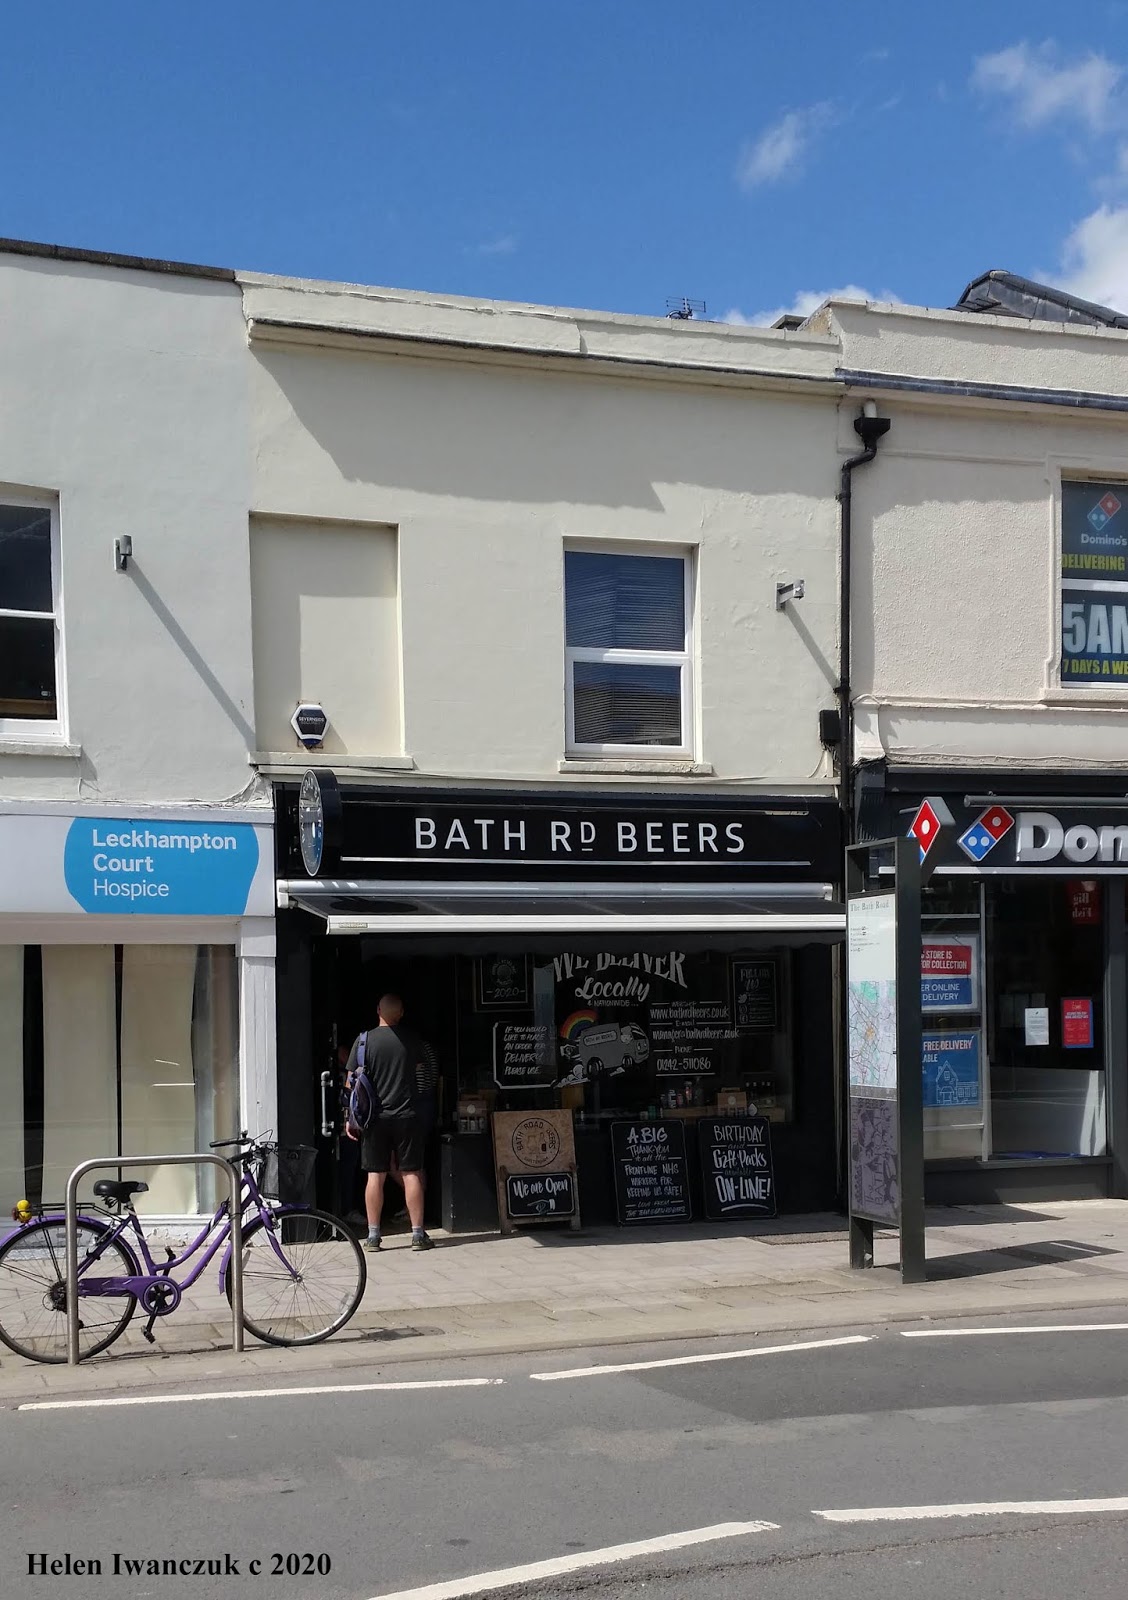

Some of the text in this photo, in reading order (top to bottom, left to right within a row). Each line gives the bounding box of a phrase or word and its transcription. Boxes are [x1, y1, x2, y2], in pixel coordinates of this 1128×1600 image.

[1081, 533, 1127, 547] Domino's
[1062, 553, 1125, 571] DELIVERING
[1064, 659, 1070, 673] 7
[1071, 659, 1100, 674] DAYS
[1102, 660, 1110, 674] A
[93, 829, 237, 853] Leckhampton
[414, 818, 526, 850] BATH
[617, 822, 746, 853] BEERS
[94, 854, 154, 873] Court
[94, 878, 169, 901] Hospice
[850, 900, 890, 911] The Bath Road
[926, 950, 945, 959] STORE
[946, 950, 953, 959] IS
[931, 960, 968, 969] COLLECTION
[495, 987, 520, 999] 2020
[575, 976, 651, 1002] Locally
[931, 983, 960, 991] ONLINE
[922, 993, 959, 1001] DELIVERY
[923, 1039, 973, 1051] FREE DELIVERY
[657, 1057, 712, 1071] 01242-511086
[516, 1131, 525, 1151] BATH
[523, 1121, 544, 1130] ROAD
[627, 1127, 668, 1144] A BIG
[713, 1125, 764, 1142] BIRTHDAY
[737, 1148, 767, 1168] Packs
[625, 1162, 679, 1176] FRONTLINE NHS
[513, 1177, 568, 1198] We are Open
[660, 1176, 674, 1186] FOR
[663, 1185, 682, 1197] SAFE!
[715, 1175, 771, 1203] ON-LINE!
